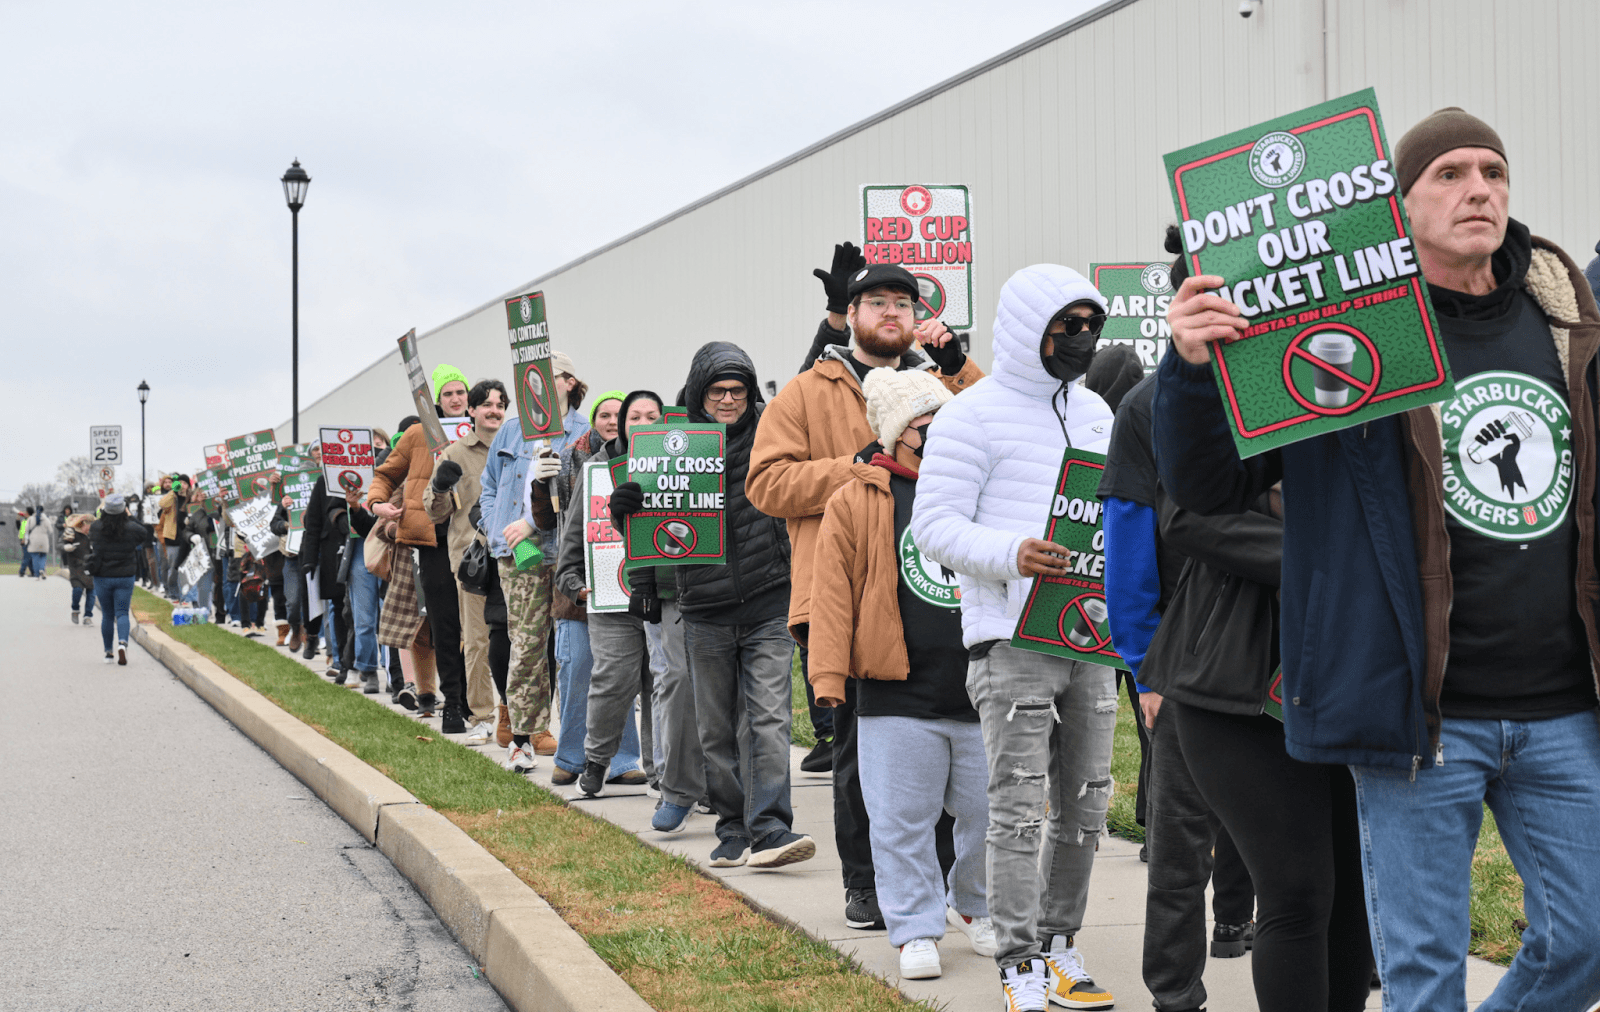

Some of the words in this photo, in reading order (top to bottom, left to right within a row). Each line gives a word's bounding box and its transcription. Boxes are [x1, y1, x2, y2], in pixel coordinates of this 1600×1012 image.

[1254, 135, 1296, 156] STARBUCKS
[1287, 151, 1302, 177] UNITED
[1253, 165, 1282, 184] WORKERS
[1182, 192, 1276, 254] DON'T
[1287, 159, 1396, 218] CROSS
[866, 217, 913, 241] RED
[920, 216, 968, 240] CUP
[864, 241, 972, 264] REBELLION
[1257, 220, 1332, 268] OUR
[1205, 261, 1325, 317] ICKET
[1334, 237, 1418, 292] LINE
[1299, 308, 1320, 324] ON
[1321, 300, 1351, 317] ULP
[1353, 285, 1408, 310] STRIKE
[1140, 318, 1172, 338] ON
[1443, 383, 1562, 429] STARBUCKS
[95, 446, 118, 461] 25
[229, 447, 250, 460] DON'T
[253, 442, 277, 453] CROSS
[246, 454, 263, 463] OUR
[322, 442, 345, 455] RED
[348, 444, 372, 455] CUP
[233, 463, 261, 476] PICKET
[322, 454, 375, 466] REBELLION
[628, 456, 671, 473] DON'T
[675, 456, 724, 473] CROSS
[284, 483, 315, 494] BARIST
[657, 475, 690, 491] OUR
[1442, 455, 1519, 526] WORKERS
[1537, 449, 1572, 517] UNITED
[243, 506, 257, 516] NO
[642, 493, 684, 509] CKET
[689, 493, 724, 509] LINE
[239, 503, 271, 528] CONTRACT
[255, 519, 268, 530] NO
[905, 556, 951, 599] WORKERS
